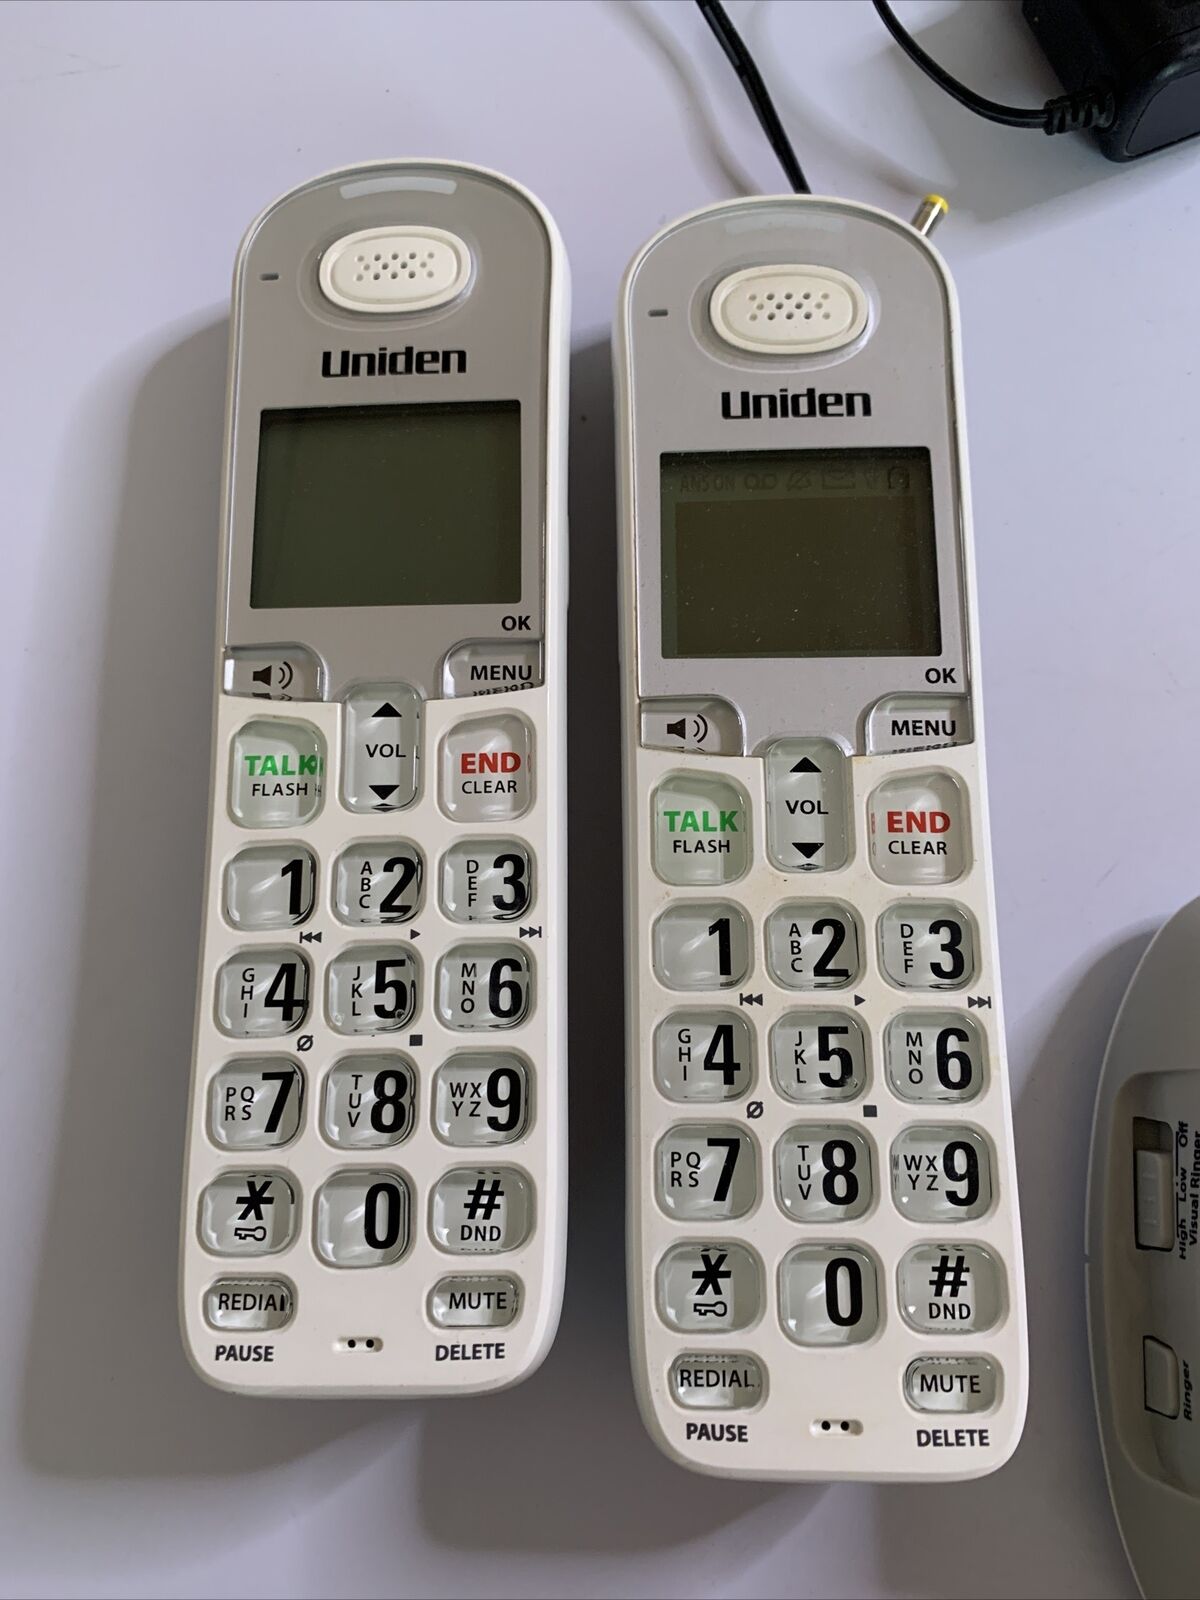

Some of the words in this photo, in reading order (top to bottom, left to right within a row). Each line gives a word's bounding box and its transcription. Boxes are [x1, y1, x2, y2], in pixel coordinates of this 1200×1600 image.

[322, 346, 467, 378] Uniden
[720, 387, 873, 420] Uniden
[501, 615, 532, 632] OK
[470, 664, 533, 681] MENU
[924, 667, 957, 684] OK
[890, 719, 957, 737] MENU
[244, 754, 317, 777] TALK
[365, 743, 407, 759] VOL
[460, 752, 521, 774] END
[251, 782, 309, 797] FLASH
[461, 780, 518, 794] CLEAR
[663, 810, 738, 833] TALK
[785, 799, 829, 816] VOL
[887, 810, 951, 834] END
[672, 838, 731, 854] FLASH
[888, 840, 948, 856] CLEAR
[280, 858, 305, 915] 1
[379, 856, 417, 914] 2
[492, 853, 527, 911] 3
[708, 917, 732, 976] 1
[811, 917, 850, 978] 2
[929, 919, 965, 980] 3
[263, 962, 308, 1021] 4
[373, 958, 408, 1019] 5
[488, 958, 524, 1019] 6
[703, 1024, 741, 1086] 4
[817, 1025, 853, 1088] 5
[935, 1026, 972, 1091] 6
[261, 1071, 296, 1134] 7
[369, 1069, 408, 1134] 8
[485, 1067, 523, 1132] 9
[1178, 1121, 1189, 1147] Off
[706, 1137, 741, 1202] 7
[820, 1139, 859, 1206] 8
[942, 1140, 980, 1207] 9
[1178, 1167, 1188, 1202] Low
[363, 1182, 401, 1250] 0
[462, 1178, 505, 1221] #
[460, 1224, 501, 1242] DND
[1188, 1193, 1200, 1246] Visual
[1177, 1218, 1189, 1260] High
[824, 1256, 863, 1327] 0
[928, 1255, 970, 1298] #
[448, 1292, 508, 1310] MUTE
[928, 1302, 972, 1320] DND
[214, 1345, 275, 1362] PAUSE
[434, 1342, 506, 1361] DELETE
[679, 1369, 753, 1388] REDIAL
[919, 1374, 982, 1394] MUTE
[1182, 1360, 1194, 1421] Ringer
[685, 1422, 749, 1442] PAUSE
[915, 1428, 991, 1447] DELETE
